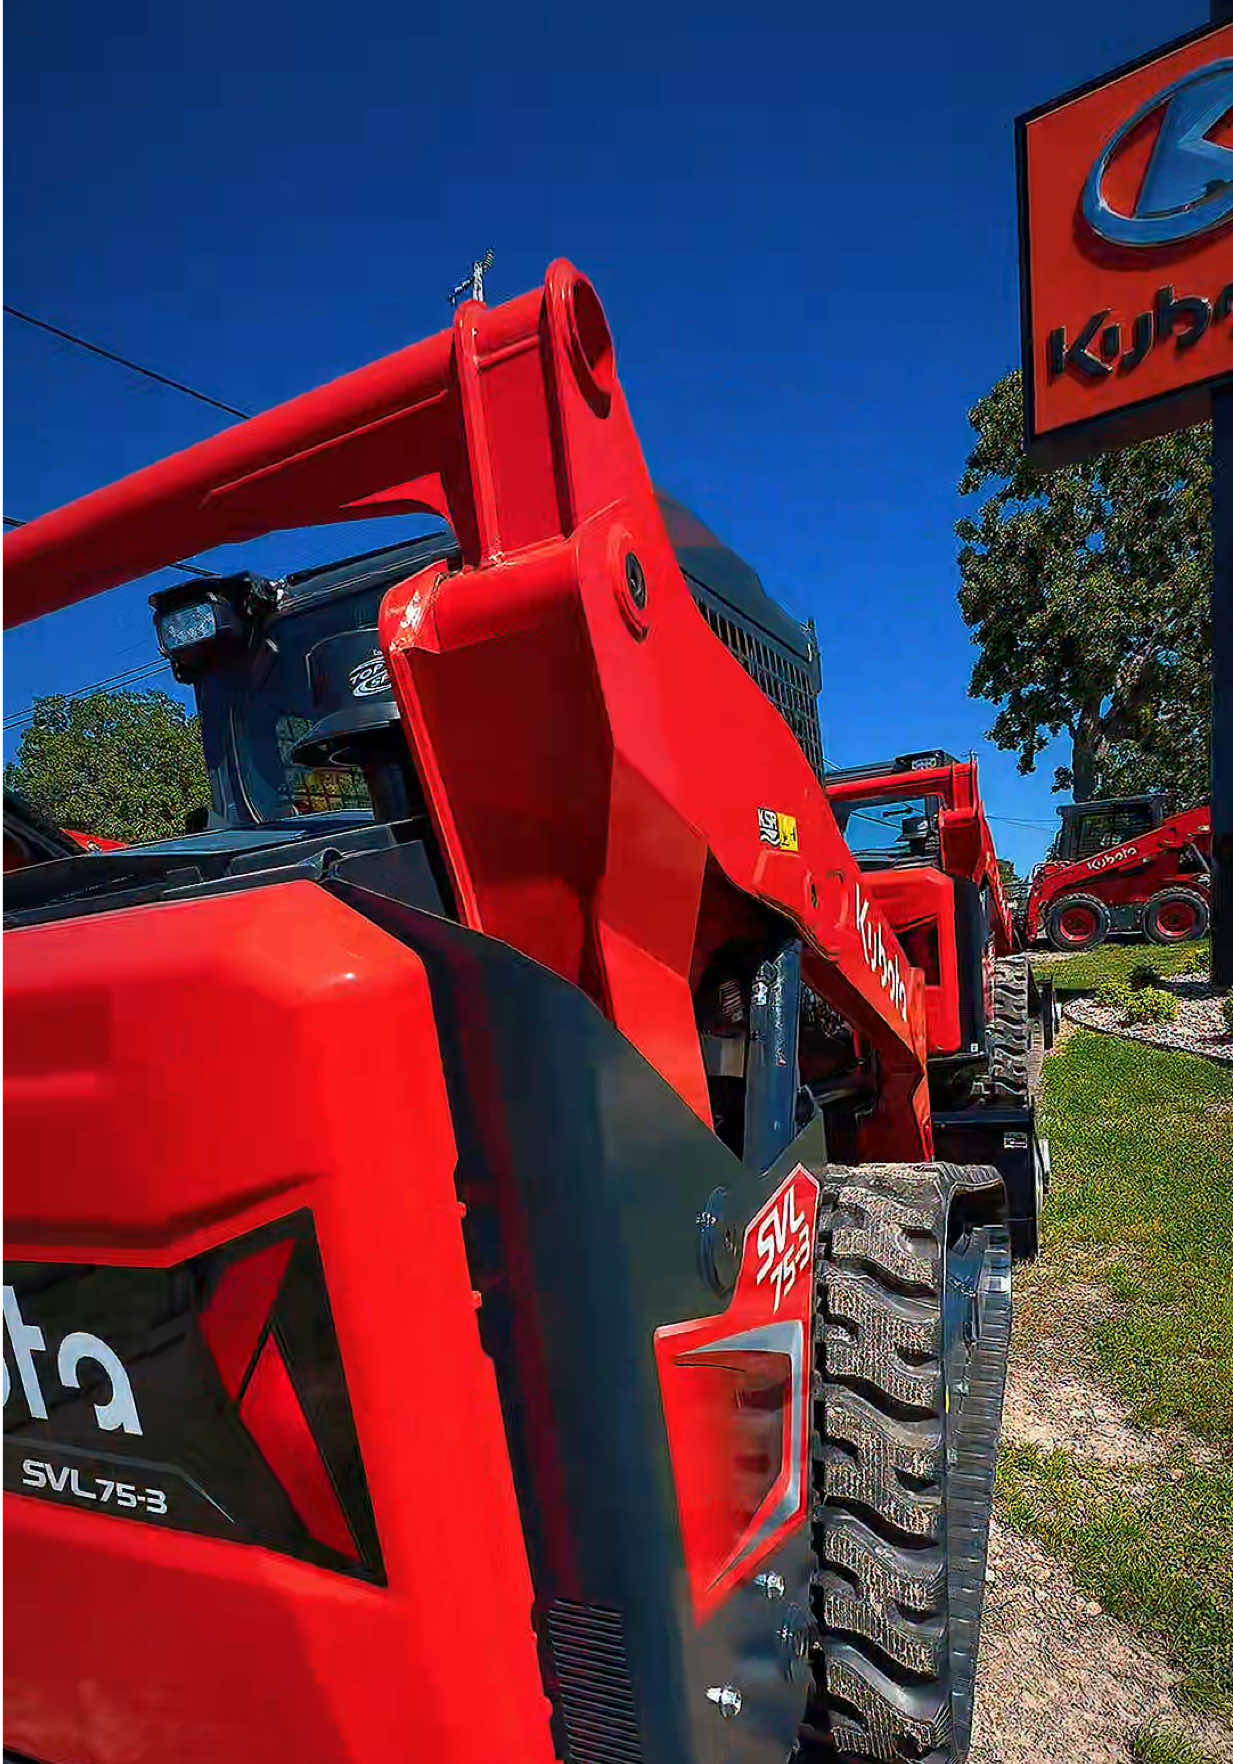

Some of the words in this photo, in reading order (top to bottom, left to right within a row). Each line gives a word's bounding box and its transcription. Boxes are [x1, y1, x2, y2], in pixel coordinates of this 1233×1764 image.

[349, 663, 384, 685] TOP
[1087, 847, 1137, 870] Kubota
[856, 881, 908, 1023] Kubota
[757, 1184, 805, 1286] SVL
[770, 1223, 811, 1315] 75-3
[3, 1284, 143, 1437] ta
